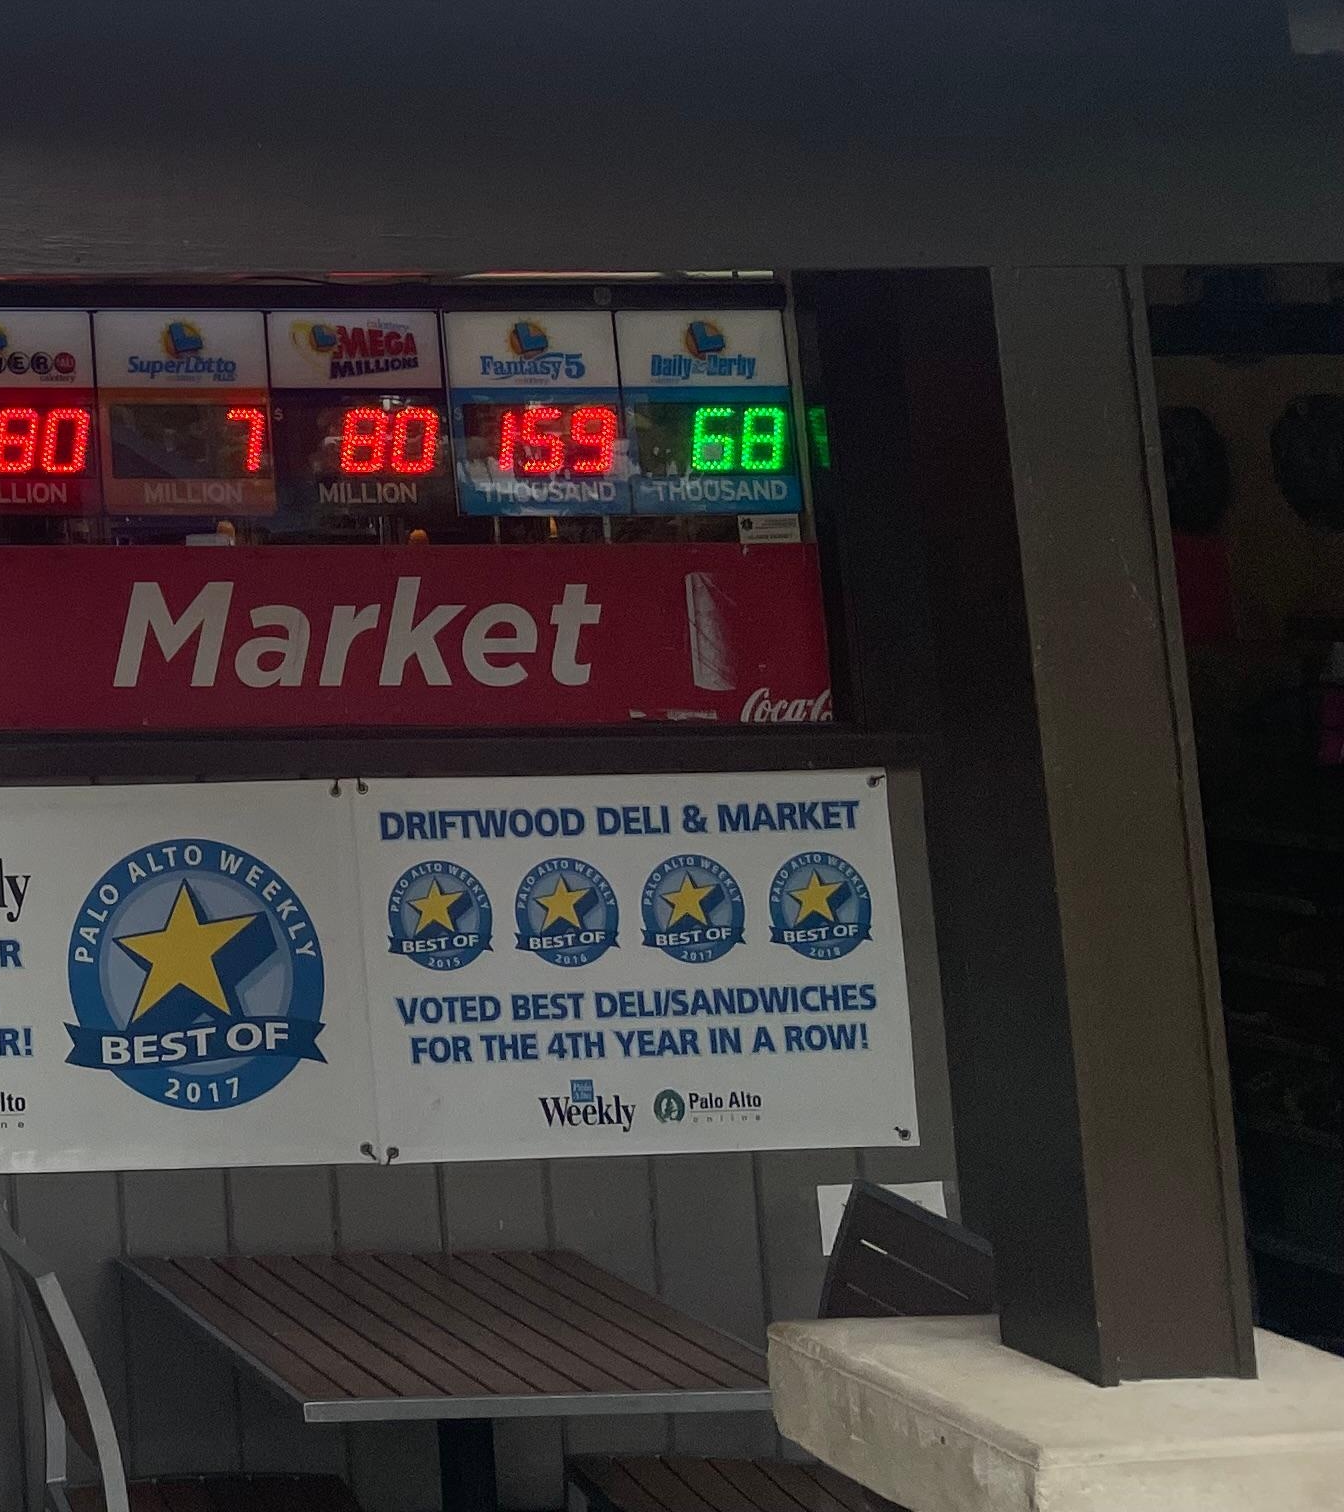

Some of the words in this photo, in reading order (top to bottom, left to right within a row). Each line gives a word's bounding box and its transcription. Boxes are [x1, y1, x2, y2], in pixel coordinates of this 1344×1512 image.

[333, 325, 418, 360] MEGA
[128, 356, 236, 379] SuperLotto
[330, 357, 419, 379] MILLIONS
[480, 353, 563, 380] Fantasy
[564, 353, 586, 379] 5
[650, 354, 692, 379] Daily
[706, 354, 756, 379] Derby
[226, 408, 266, 473] 7
[340, 407, 439, 474] 80
[498, 407, 617, 474] 159
[691, 406, 785, 471] 68
[144, 482, 243, 504] MILLION
[319, 482, 418, 504] MILLION
[484, 480, 616, 503] THOUSAND
[658, 479, 788, 501] THOUSAND
[113, 576, 602, 687] Market
[380, 809, 585, 841] DRIFTWOOD
[596, 805, 670, 837] DELI
[682, 804, 708, 834] &
[717, 800, 860, 832] MARKET
[391, 879, 408, 912] PALO
[411, 863, 442, 879] ALTO
[448, 865, 489, 909] WEEKLY
[517, 876, 535, 909] PALO
[537, 860, 569, 876] ALTO
[575, 862, 616, 906] WEEKLY
[644, 873, 661, 905] PALO
[664, 857, 694, 872] ALTO
[700, 858, 742, 902] WEEKLY
[771, 870, 788, 902] PALO
[791, 854, 822, 869] ALTO
[828, 855, 868, 900] WEEKLY
[75, 883, 119, 963] PALO
[127, 845, 202, 883] ALTO
[219, 849, 316, 959] WEEKLY
[402, 937, 449, 953] BEST
[453, 934, 479, 947] OF
[529, 934, 576, 949] BEST
[579, 931, 606, 944] OF
[655, 930, 702, 946] BEST
[706, 928, 732, 940] OF
[783, 927, 829, 943] BEST
[833, 924, 859, 937] OF
[428, 957, 461, 967] 2015
[555, 953, 587, 964] 2016
[681, 950, 712, 961] 2017
[396, 995, 501, 1025] VOTED
[513, 992, 585, 1022] BEST
[595, 984, 877, 1019] DELI/SANDWICHES
[101, 1027, 216, 1065] BEST
[226, 1022, 289, 1052] OF
[412, 1035, 472, 1064] FOR
[480, 1033, 538, 1061] THE
[548, 1031, 605, 1059] 4TH
[616, 1028, 700, 1057] YEAR
[711, 1026, 742, 1054] IN
[752, 1024, 776, 1053] A
[785, 1022, 869, 1051] ROW!
[164, 1077, 240, 1103] 2017
[689, 1092, 723, 1109] Palo
[728, 1091, 762, 1108] Alto
[538, 1094, 636, 1132] Weekly
